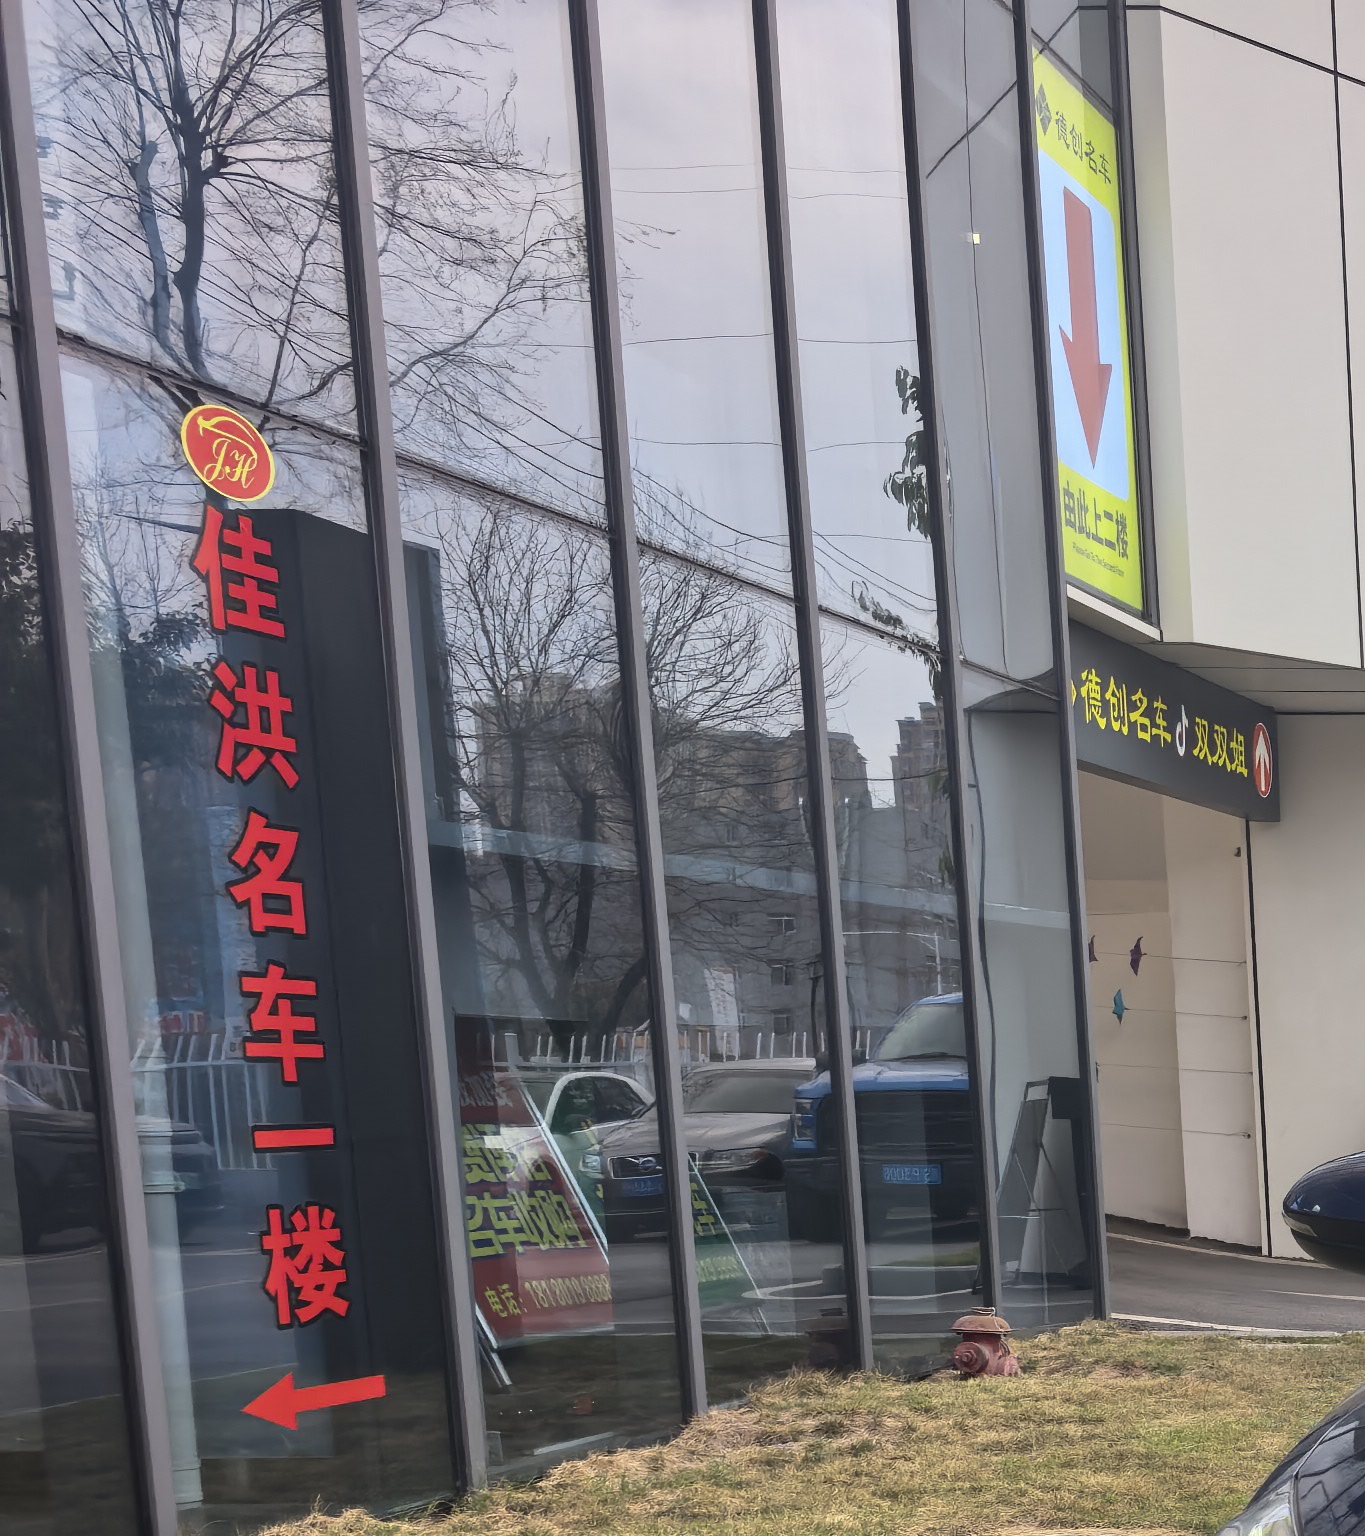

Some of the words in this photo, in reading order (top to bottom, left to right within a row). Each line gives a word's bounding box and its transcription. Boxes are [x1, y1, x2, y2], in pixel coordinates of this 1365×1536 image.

[1055, 110, 1111, 184] 德创名车
[1062, 480, 1128, 560] 由此上二楼
[1080, 668, 1172, 748] 德创名车
[1192, 716, 1248, 777] 双双姐
[192, 504, 350, 1325] 佳洪名车一楼
